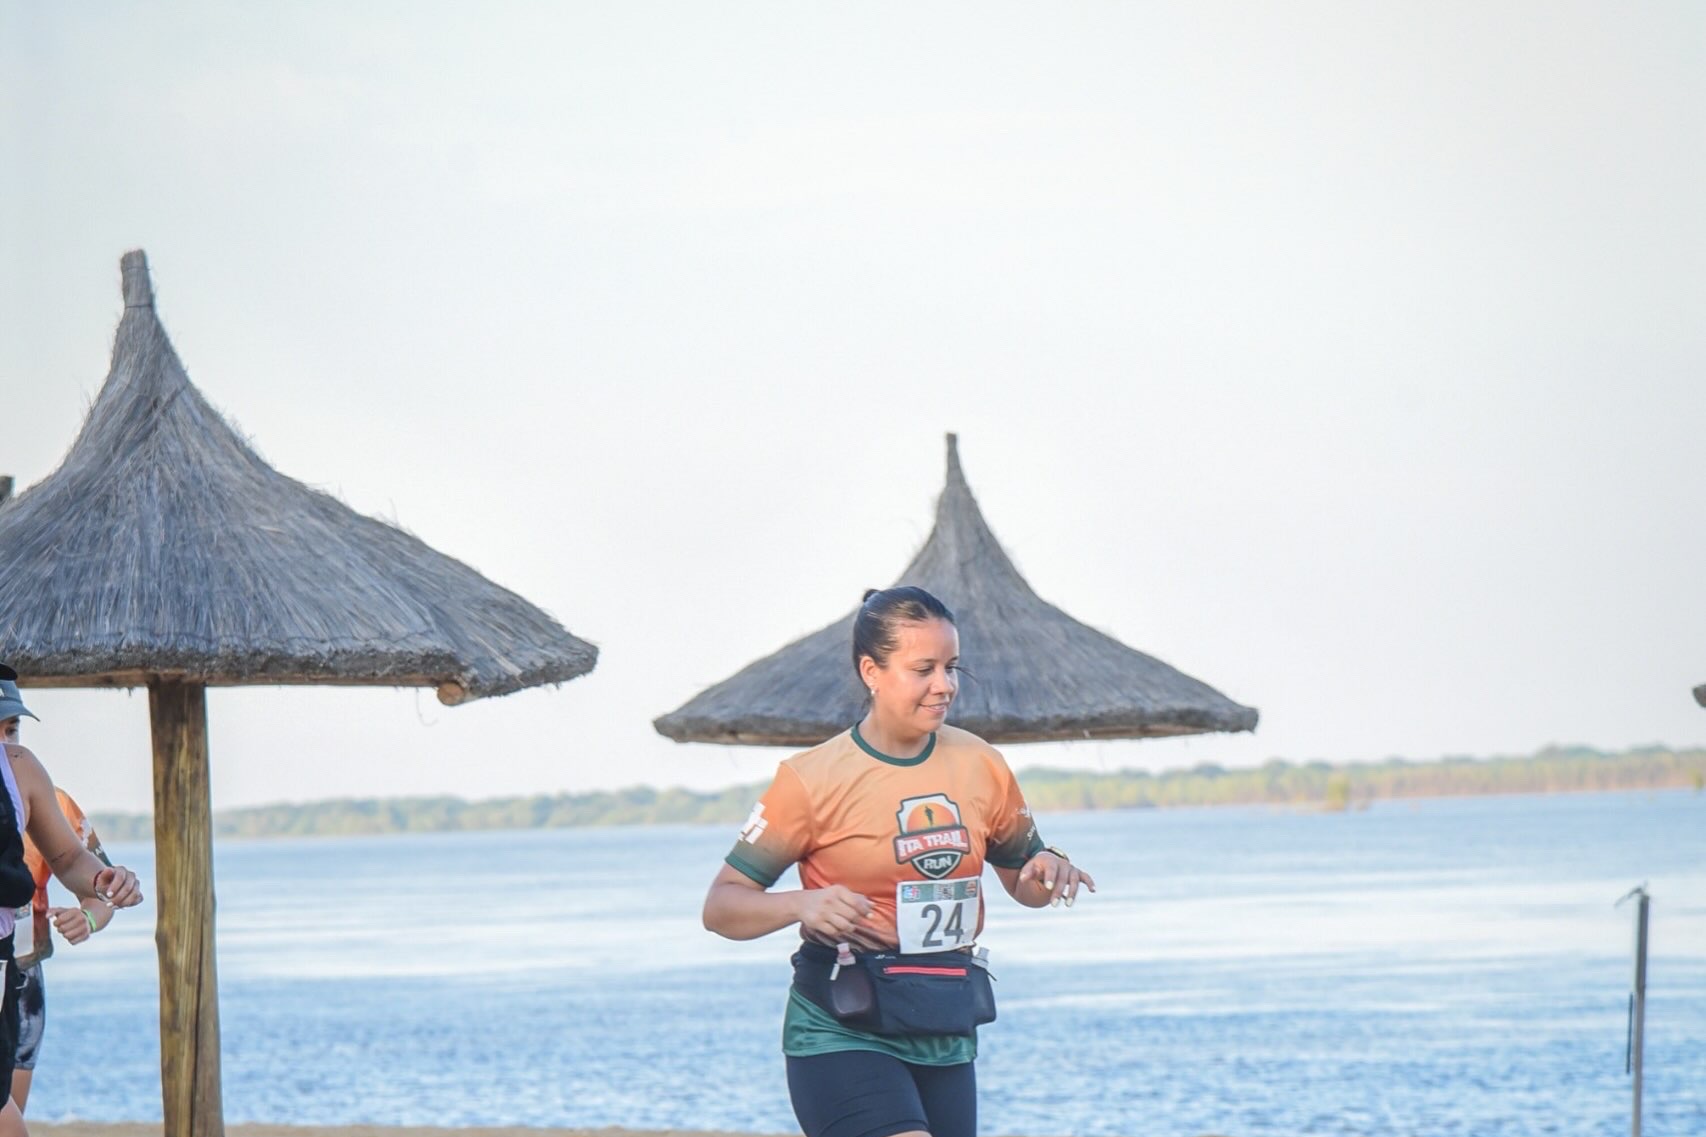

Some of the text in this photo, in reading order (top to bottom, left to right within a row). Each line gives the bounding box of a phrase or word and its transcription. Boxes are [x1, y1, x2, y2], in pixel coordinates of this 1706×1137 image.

[897, 830, 968, 857] ITA TRAIL
[923, 855, 953, 870] RUN
[920, 902, 964, 948] 24
